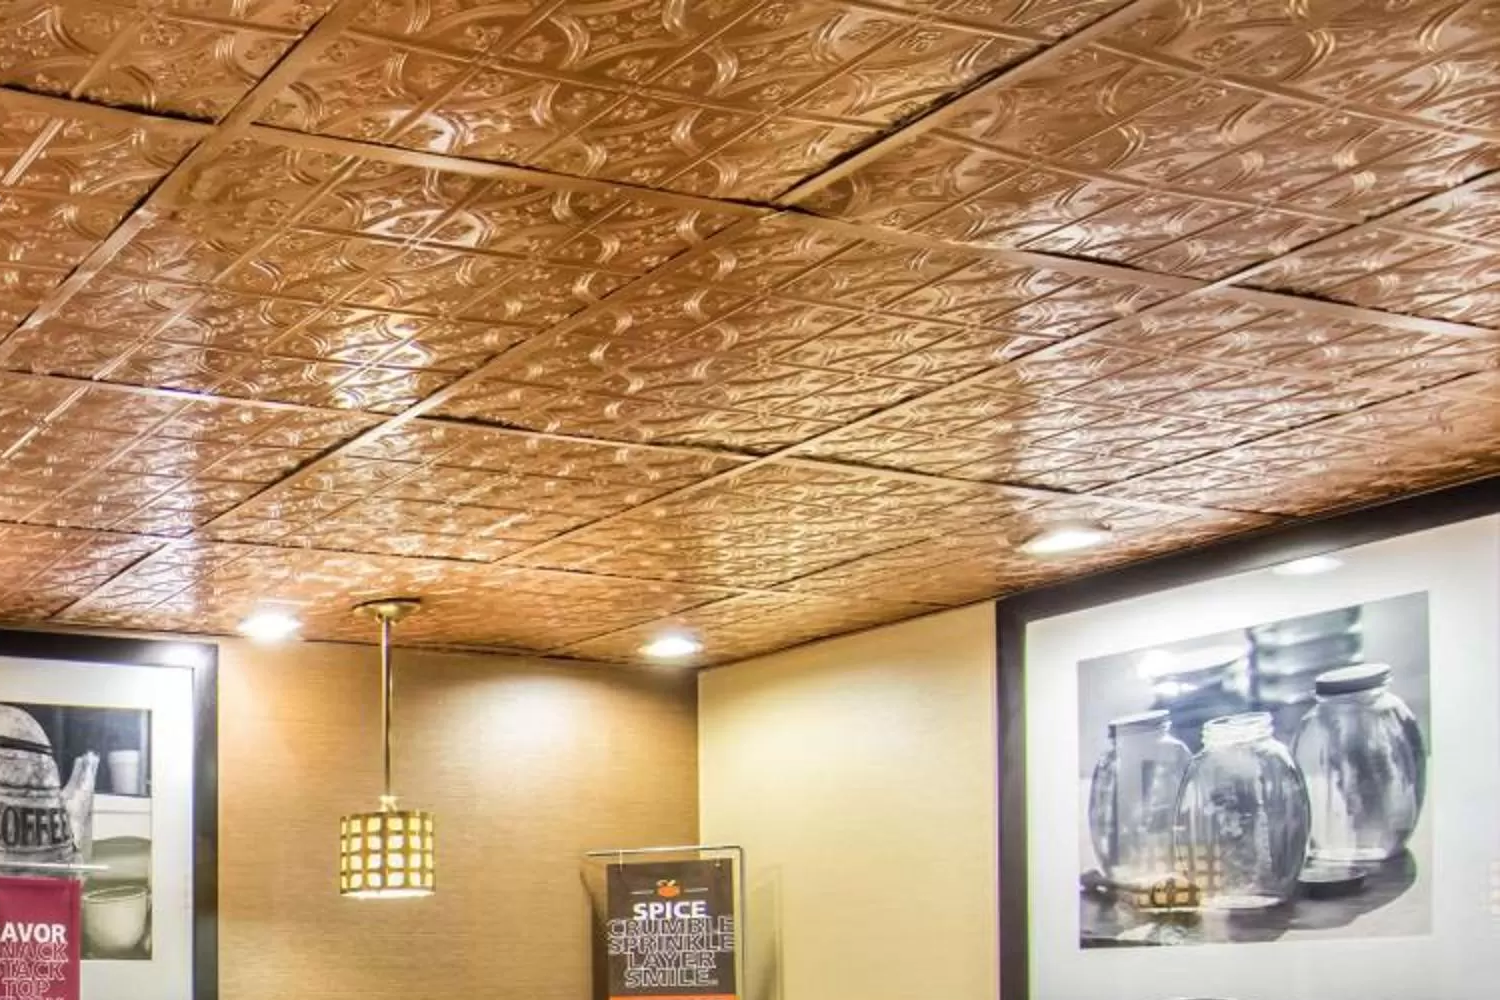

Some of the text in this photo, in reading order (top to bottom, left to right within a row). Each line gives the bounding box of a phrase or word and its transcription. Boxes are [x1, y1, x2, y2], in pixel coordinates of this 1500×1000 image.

[633, 900, 707, 920] SPICE
[606, 914, 735, 937] CRUMBLE
[607, 932, 735, 955] SPRINKLE
[627, 951, 717, 970] LAYER
[1, 977, 51, 998] TOP
